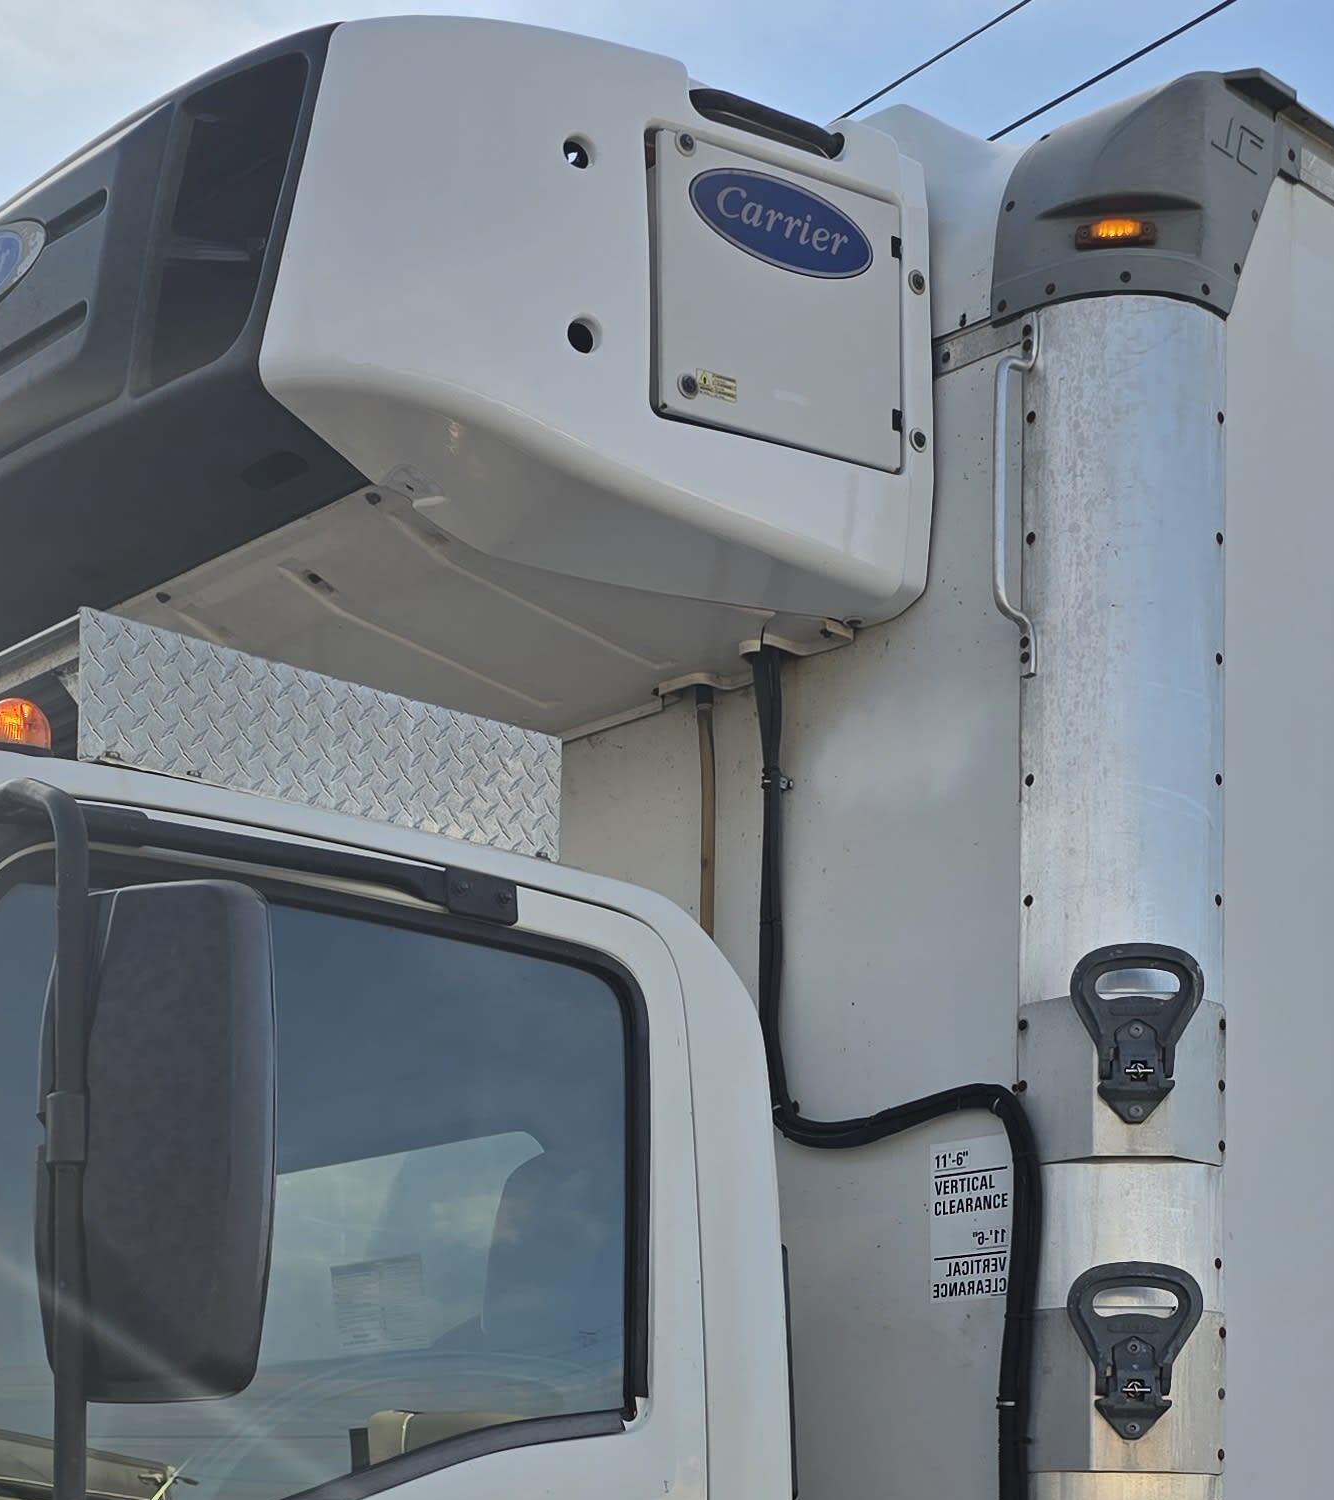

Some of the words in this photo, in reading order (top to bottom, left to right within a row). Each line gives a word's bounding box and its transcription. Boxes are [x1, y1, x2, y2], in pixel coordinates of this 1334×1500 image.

[716, 186, 849, 256] Carrier
[934, 1150, 969, 1169] 11'-6"
[934, 1174, 995, 1196] VERTICAL
[934, 1193, 1009, 1217] CLEARANCE
